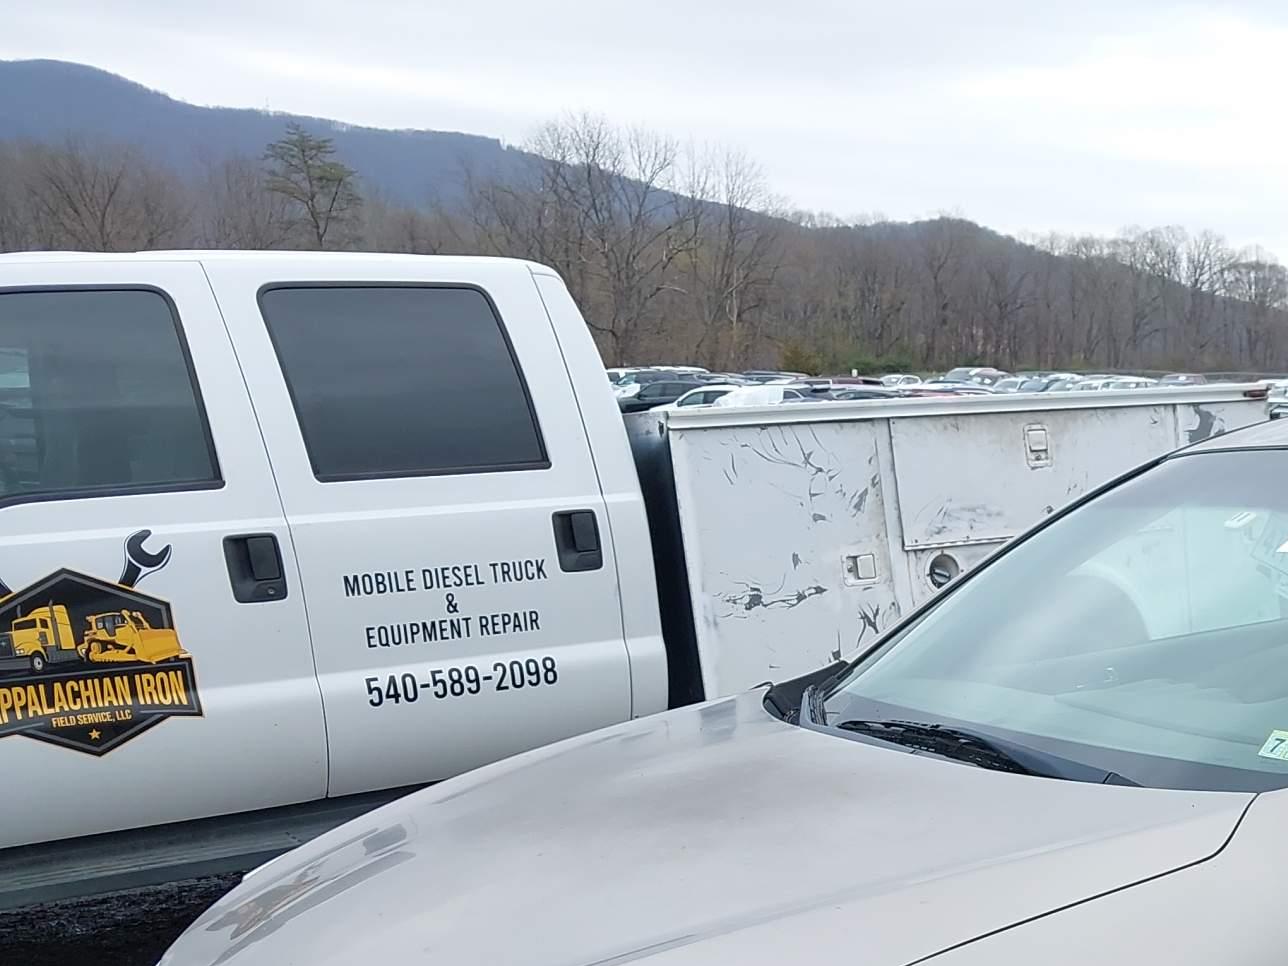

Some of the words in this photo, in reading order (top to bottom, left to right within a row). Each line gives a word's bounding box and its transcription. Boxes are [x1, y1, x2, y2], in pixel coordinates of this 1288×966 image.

[343, 570, 417, 597] MOBILE
[422, 564, 485, 590] DIESEL
[489, 559, 548, 583] TRUCK
[445, 593, 459, 613] &
[365, 617, 472, 648] EQUIPMENT
[478, 610, 541, 636] REPAIR
[134, 670, 188, 706] IRON
[364, 656, 559, 707] 540-589-2098
[52, 714, 76, 728] FIELD
[78, 711, 115, 725] SERVICE,
[116, 709, 132, 721] LLC
[1270, 738, 1286, 752] 7
